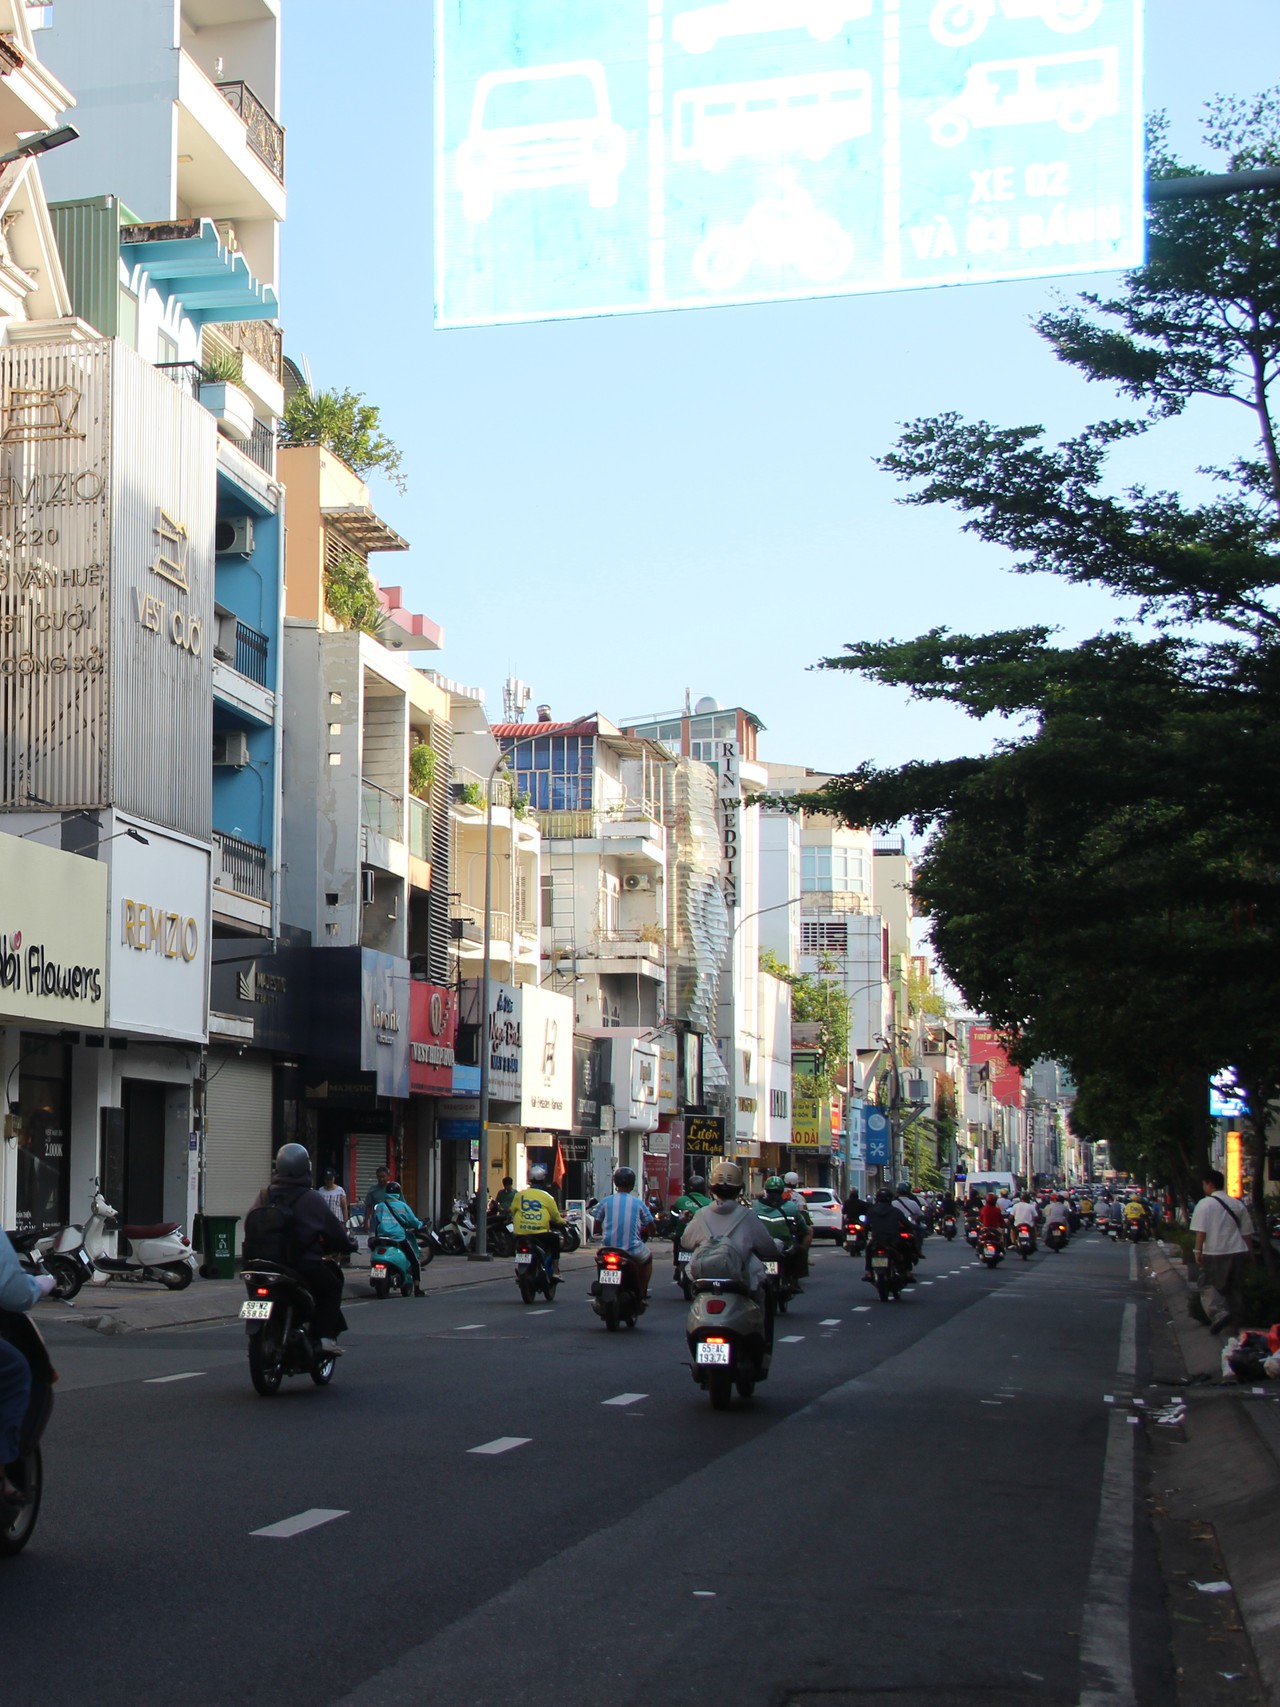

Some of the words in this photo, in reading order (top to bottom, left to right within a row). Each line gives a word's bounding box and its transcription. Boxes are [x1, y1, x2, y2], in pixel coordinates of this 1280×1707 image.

[969, 167, 1015, 204] XE
[1025, 161, 1069, 196] 02
[910, 215, 957, 260] VÀ
[14, 528, 59, 548] 220
[13, 565, 57, 589] VĂN
[61, 563, 101, 588] HUÊ
[131, 586, 166, 635] VEST
[0, 650, 68, 676] CÔNG
[721, 742, 736, 789] RIN
[721, 797, 738, 908] WEDDING
[25, 943, 102, 1003] Flowers
[521, 1195, 542, 1212] be
